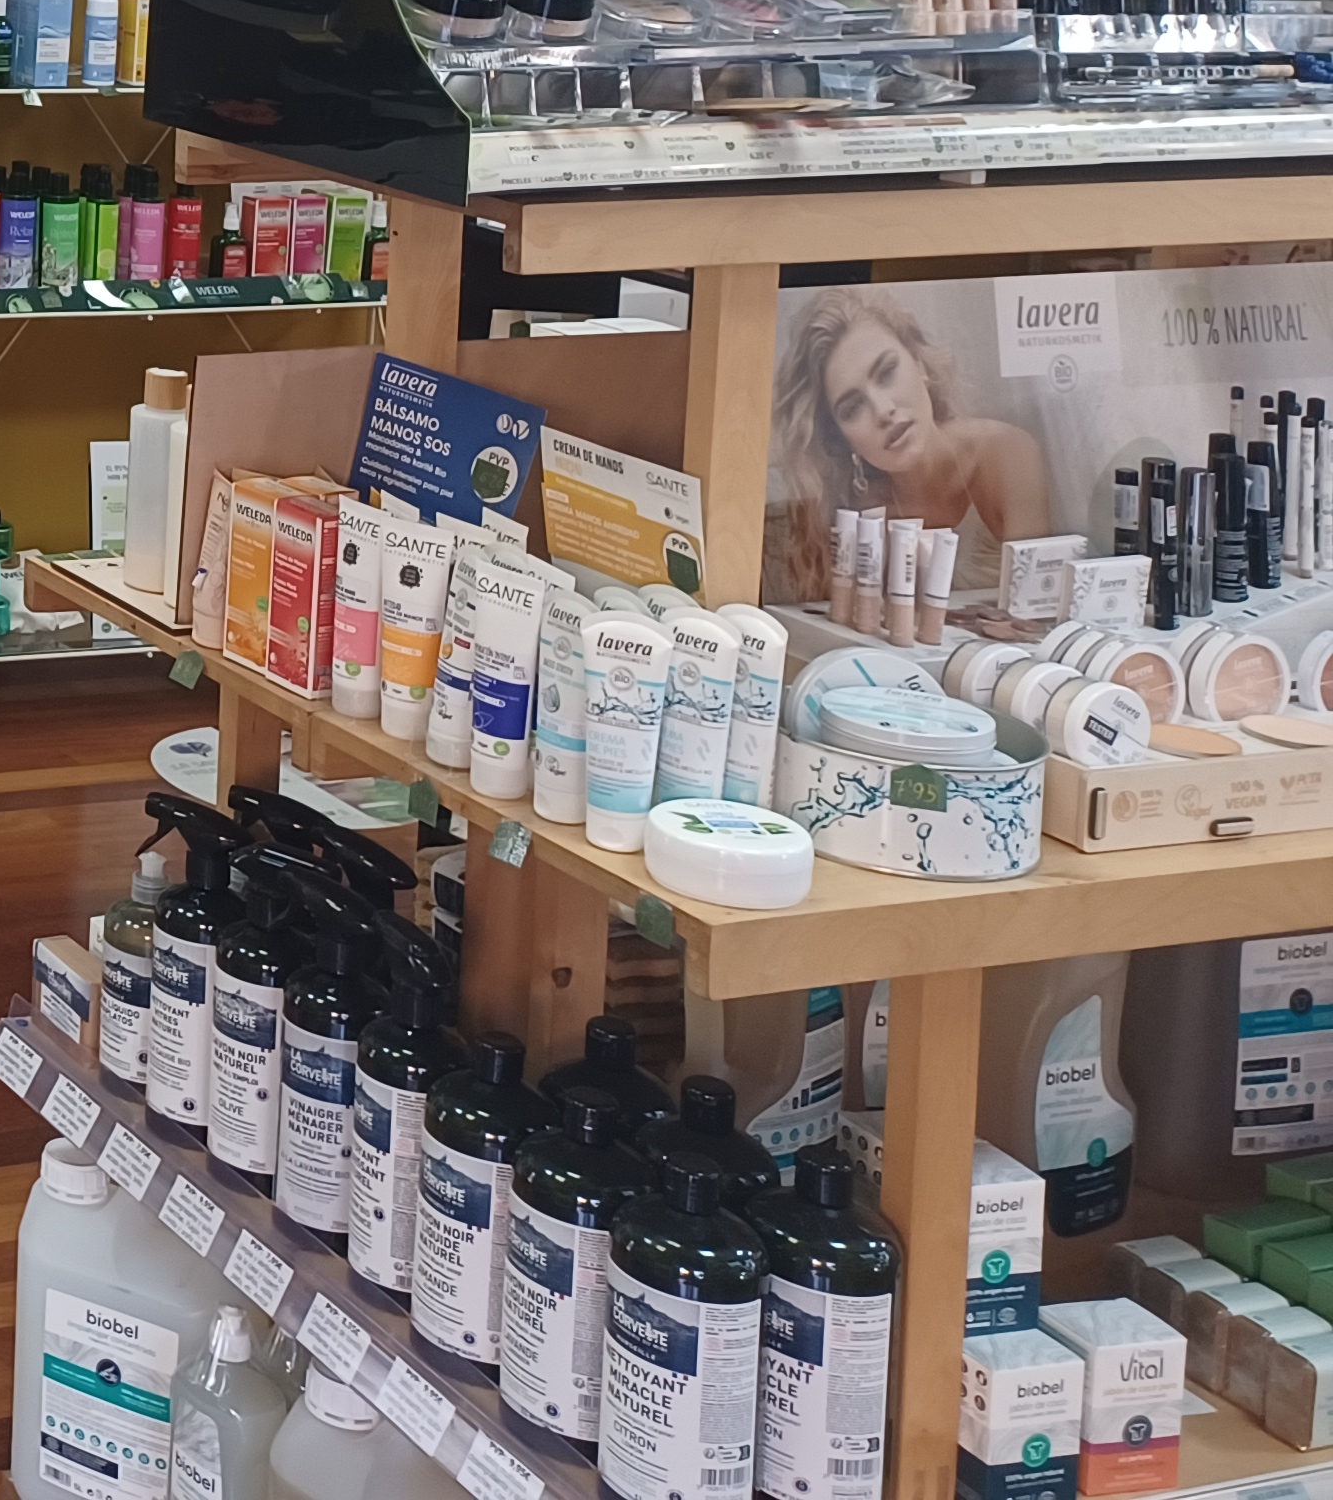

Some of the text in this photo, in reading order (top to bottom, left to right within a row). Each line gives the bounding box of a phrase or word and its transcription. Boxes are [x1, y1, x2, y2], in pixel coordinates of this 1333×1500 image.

[260, 209, 287, 218] WELEDA
[298, 209, 324, 217] WELEDA
[338, 208, 364, 216] WELEDA
[195, 284, 239, 297] WELEDA
[1017, 296, 1099, 330] lavera
[1164, 303, 1309, 348] 100 % NATURAL
[1018, 334, 1102, 347] NATURKOSMETIK
[381, 362, 438, 397] lavera
[375, 398, 440, 431] BÁLSAMO
[368, 430, 414, 454] Macadamia
[371, 416, 451, 456] MANOS SOS
[401, 453, 411, 463] de
[488, 452, 510, 467] PVP
[553, 439, 581, 458] CREMA
[583, 449, 594, 464] DE
[596, 454, 624, 474] MANOS
[362, 456, 391, 473] Cuidado
[423, 480, 439, 494] para
[646, 471, 689, 497] SANTE
[236, 503, 272, 525] WELEDA
[337, 510, 380, 538] SANTE
[278, 520, 313, 543] WELEDA
[386, 531, 447, 559] SANTE
[671, 537, 689, 552] PVP
[478, 577, 535, 609] SANTE
[597, 631, 653, 656] lavera
[588, 729, 625, 746] CREMA
[588, 743, 627, 759] DE PIES
[1278, 942, 1327, 961] biobel
[214, 1050, 258, 1075] NATUREL
[238, 1049, 266, 1065] NOIR
[291, 1048, 302, 1062] LA
[1046, 1063, 1096, 1086] biobel
[218, 1098, 244, 1116] OLIVE
[289, 1096, 343, 1122] VINAIGRE
[288, 1122, 341, 1145] NATUREL
[295, 1159, 332, 1178] LAVANDE
[976, 1197, 1024, 1214] biobel
[421, 1218, 460, 1252] LIQUIDE
[443, 1222, 474, 1244] NOIR
[528, 1289, 556, 1312] NOIR
[614, 1291, 624, 1309] LA
[86, 1309, 138, 1339] biobel
[1120, 1358, 1163, 1381] Vital
[610, 1364, 672, 1410] MIRACLE
[1017, 1380, 1064, 1399] biobel
[608, 1380, 674, 1428] NATUREL
[614, 1419, 656, 1452] CITRON
[175, 1451, 215, 1493] biobel
